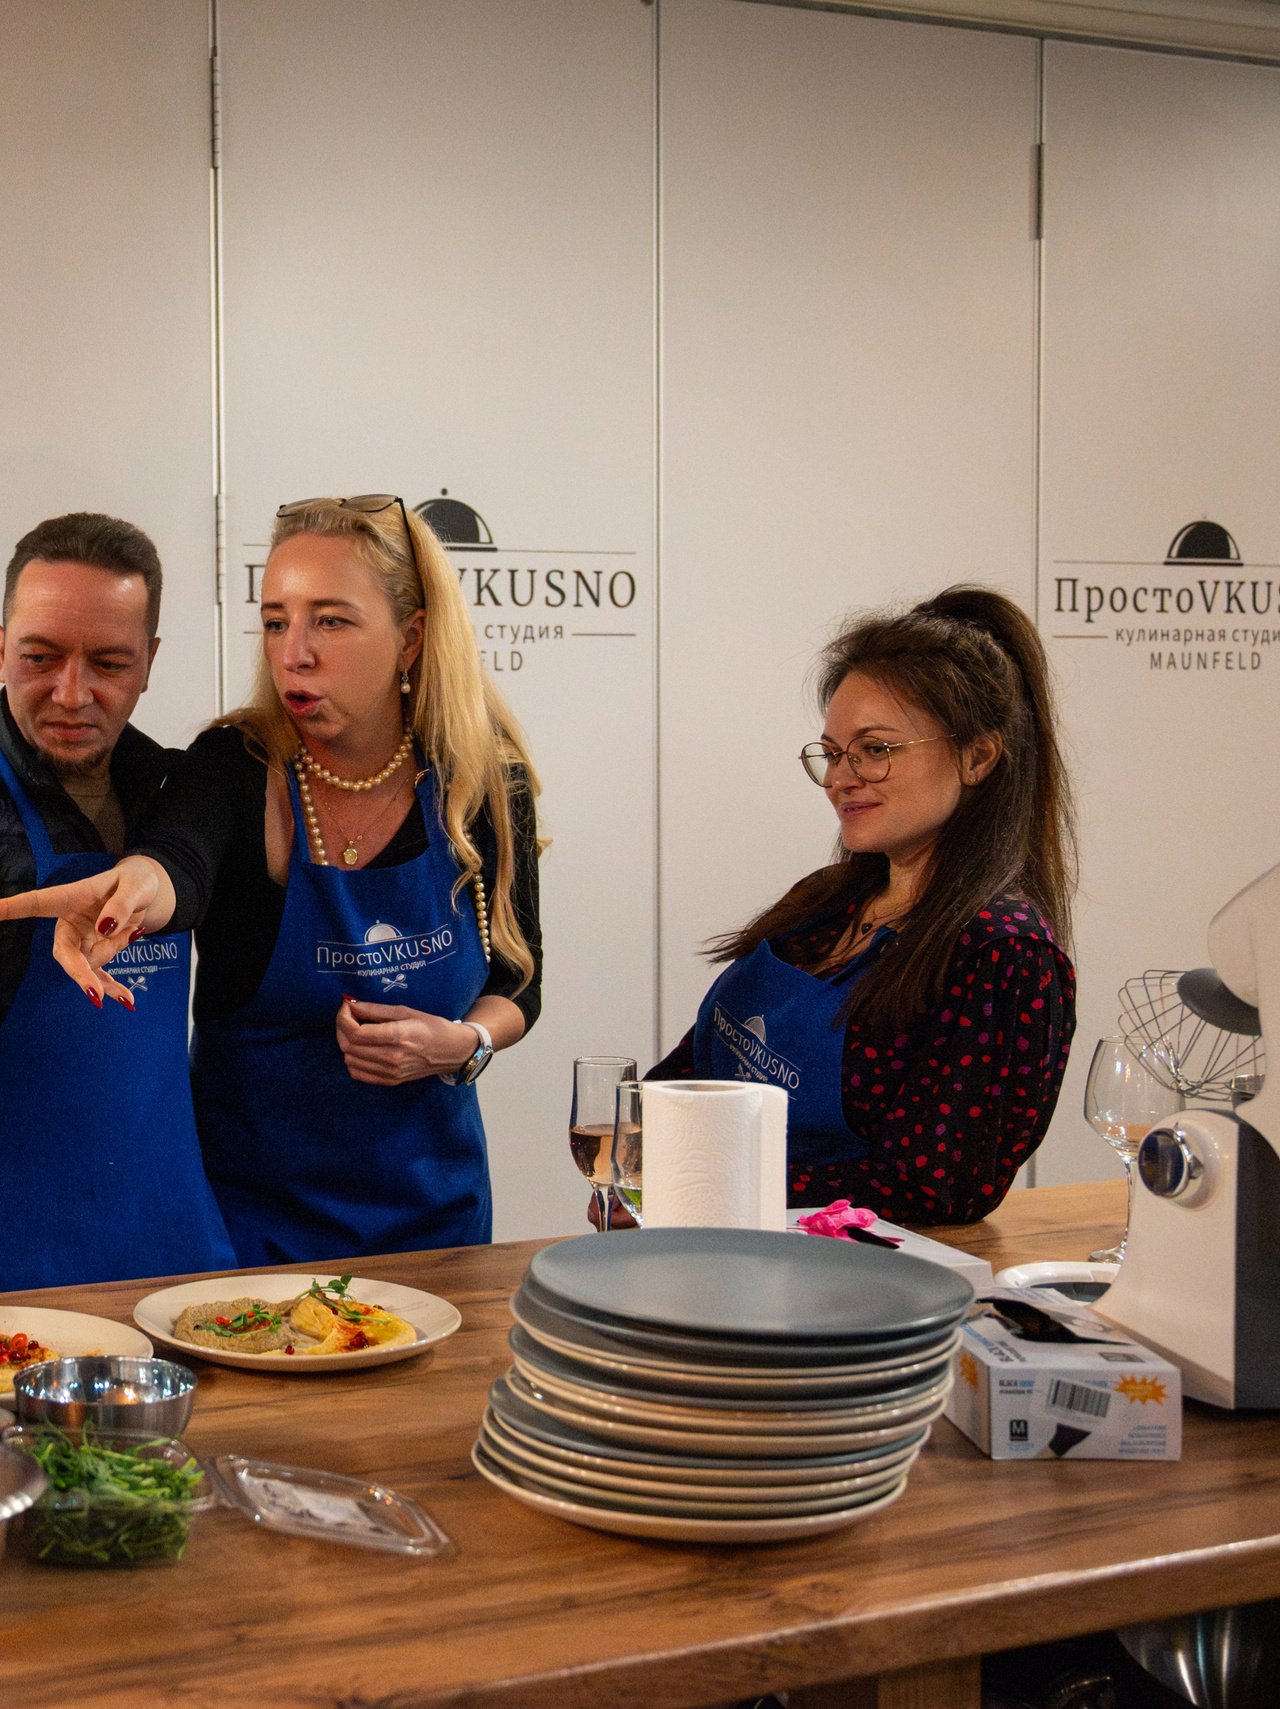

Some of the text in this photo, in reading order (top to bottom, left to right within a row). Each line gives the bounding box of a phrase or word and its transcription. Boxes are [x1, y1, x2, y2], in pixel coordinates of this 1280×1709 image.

[1054, 578, 1280, 623] ПростоVKU
[484, 624, 563, 645] студия
[1116, 627, 1226, 646] кулинарная
[1150, 651, 1261, 670] MAUNFELD
[317, 930, 453, 967] ПростоVKUSNO
[714, 1007, 800, 1090] ПростоVKUSNO
